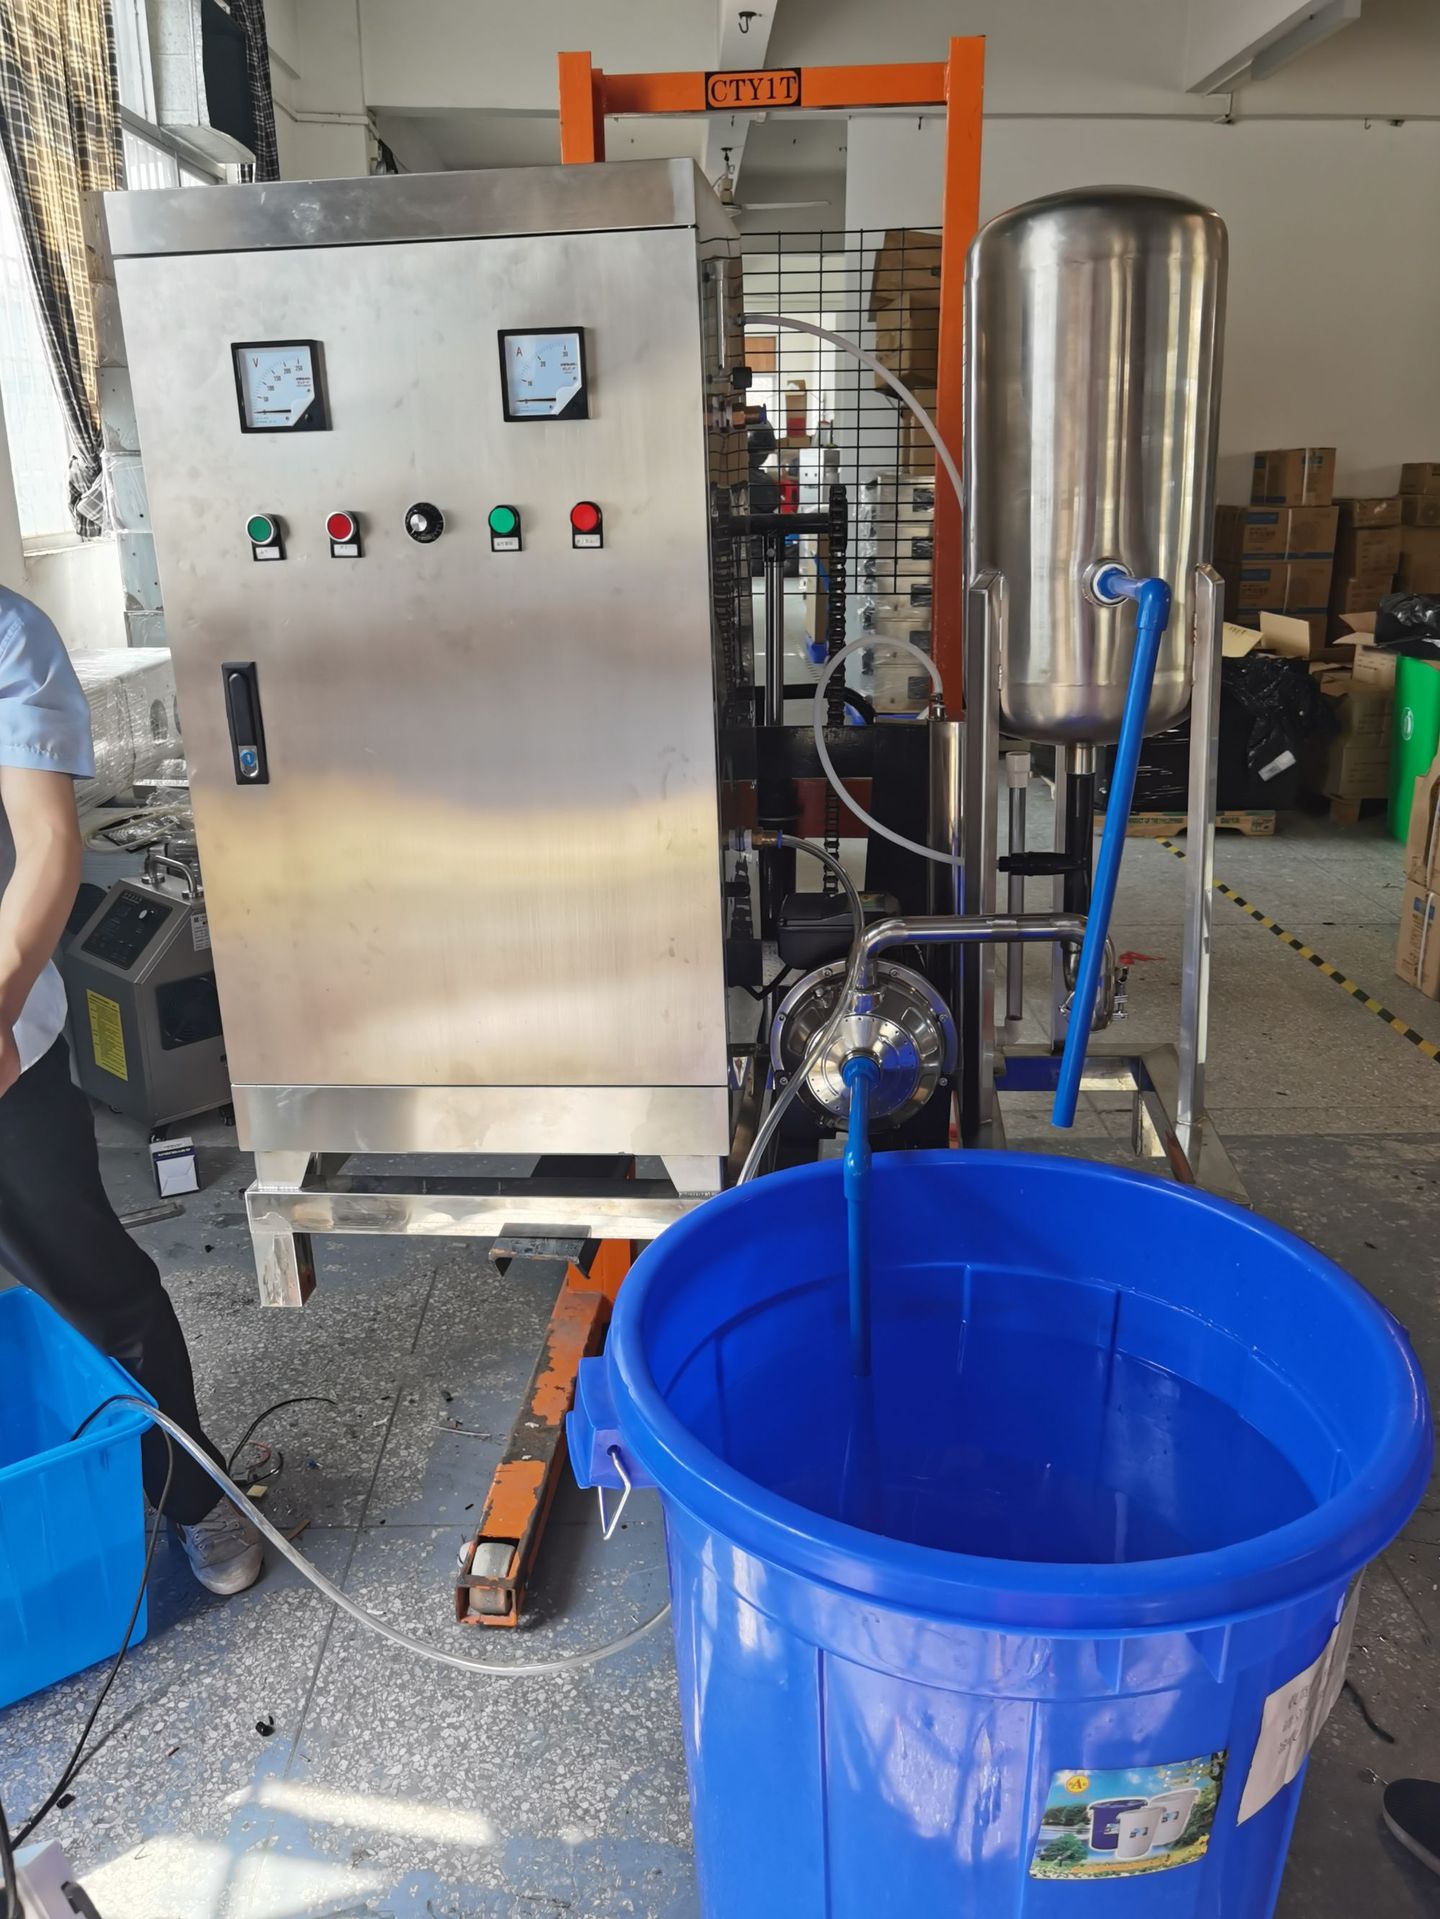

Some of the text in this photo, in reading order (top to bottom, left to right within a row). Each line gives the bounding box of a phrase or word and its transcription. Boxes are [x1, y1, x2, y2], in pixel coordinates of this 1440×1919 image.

[711, 76, 797, 102] CTY1T
[516, 347, 523, 357] A
[252, 357, 259, 368] V
